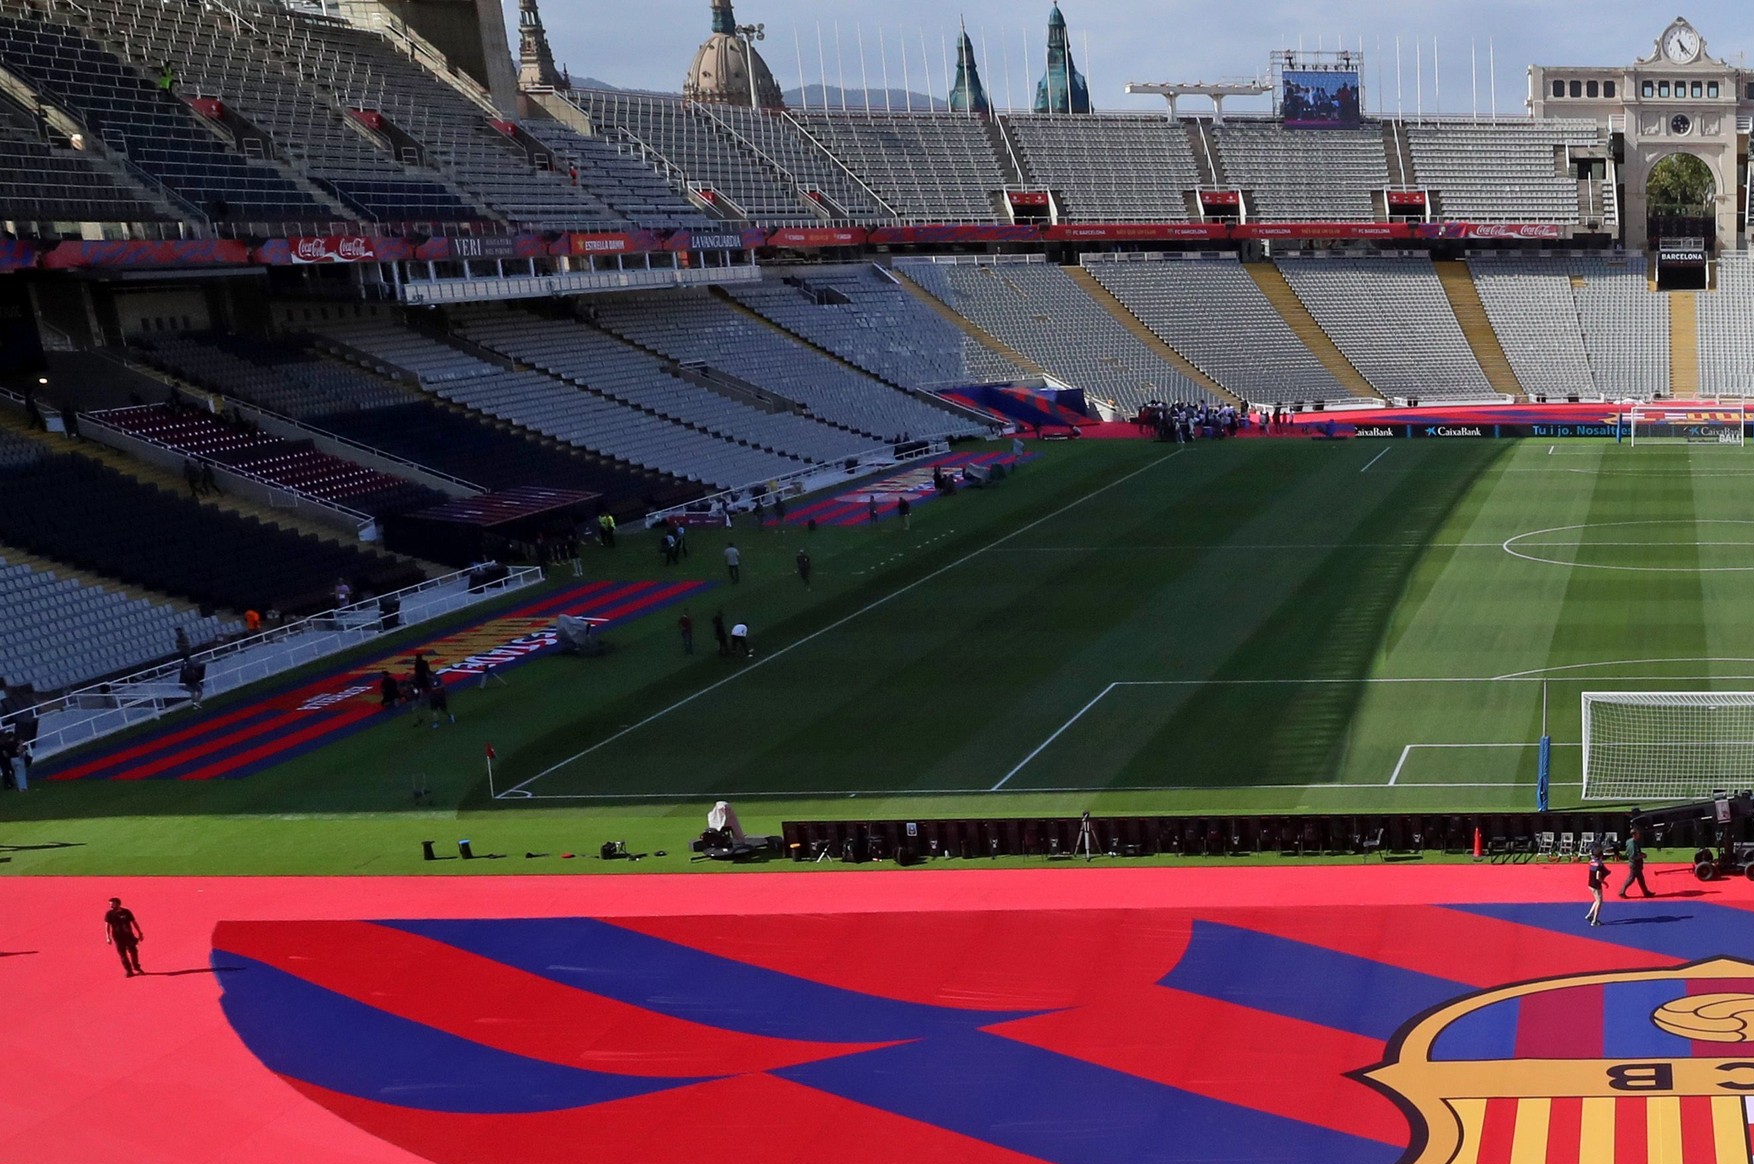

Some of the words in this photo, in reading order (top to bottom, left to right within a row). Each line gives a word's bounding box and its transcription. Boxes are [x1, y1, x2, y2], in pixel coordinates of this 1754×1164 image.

[455, 239, 481, 256] VERI
[1438, 427, 1481, 437] CaixaBank
[1533, 426, 1546, 435] Tu
[1557, 426, 1573, 437] jo.
